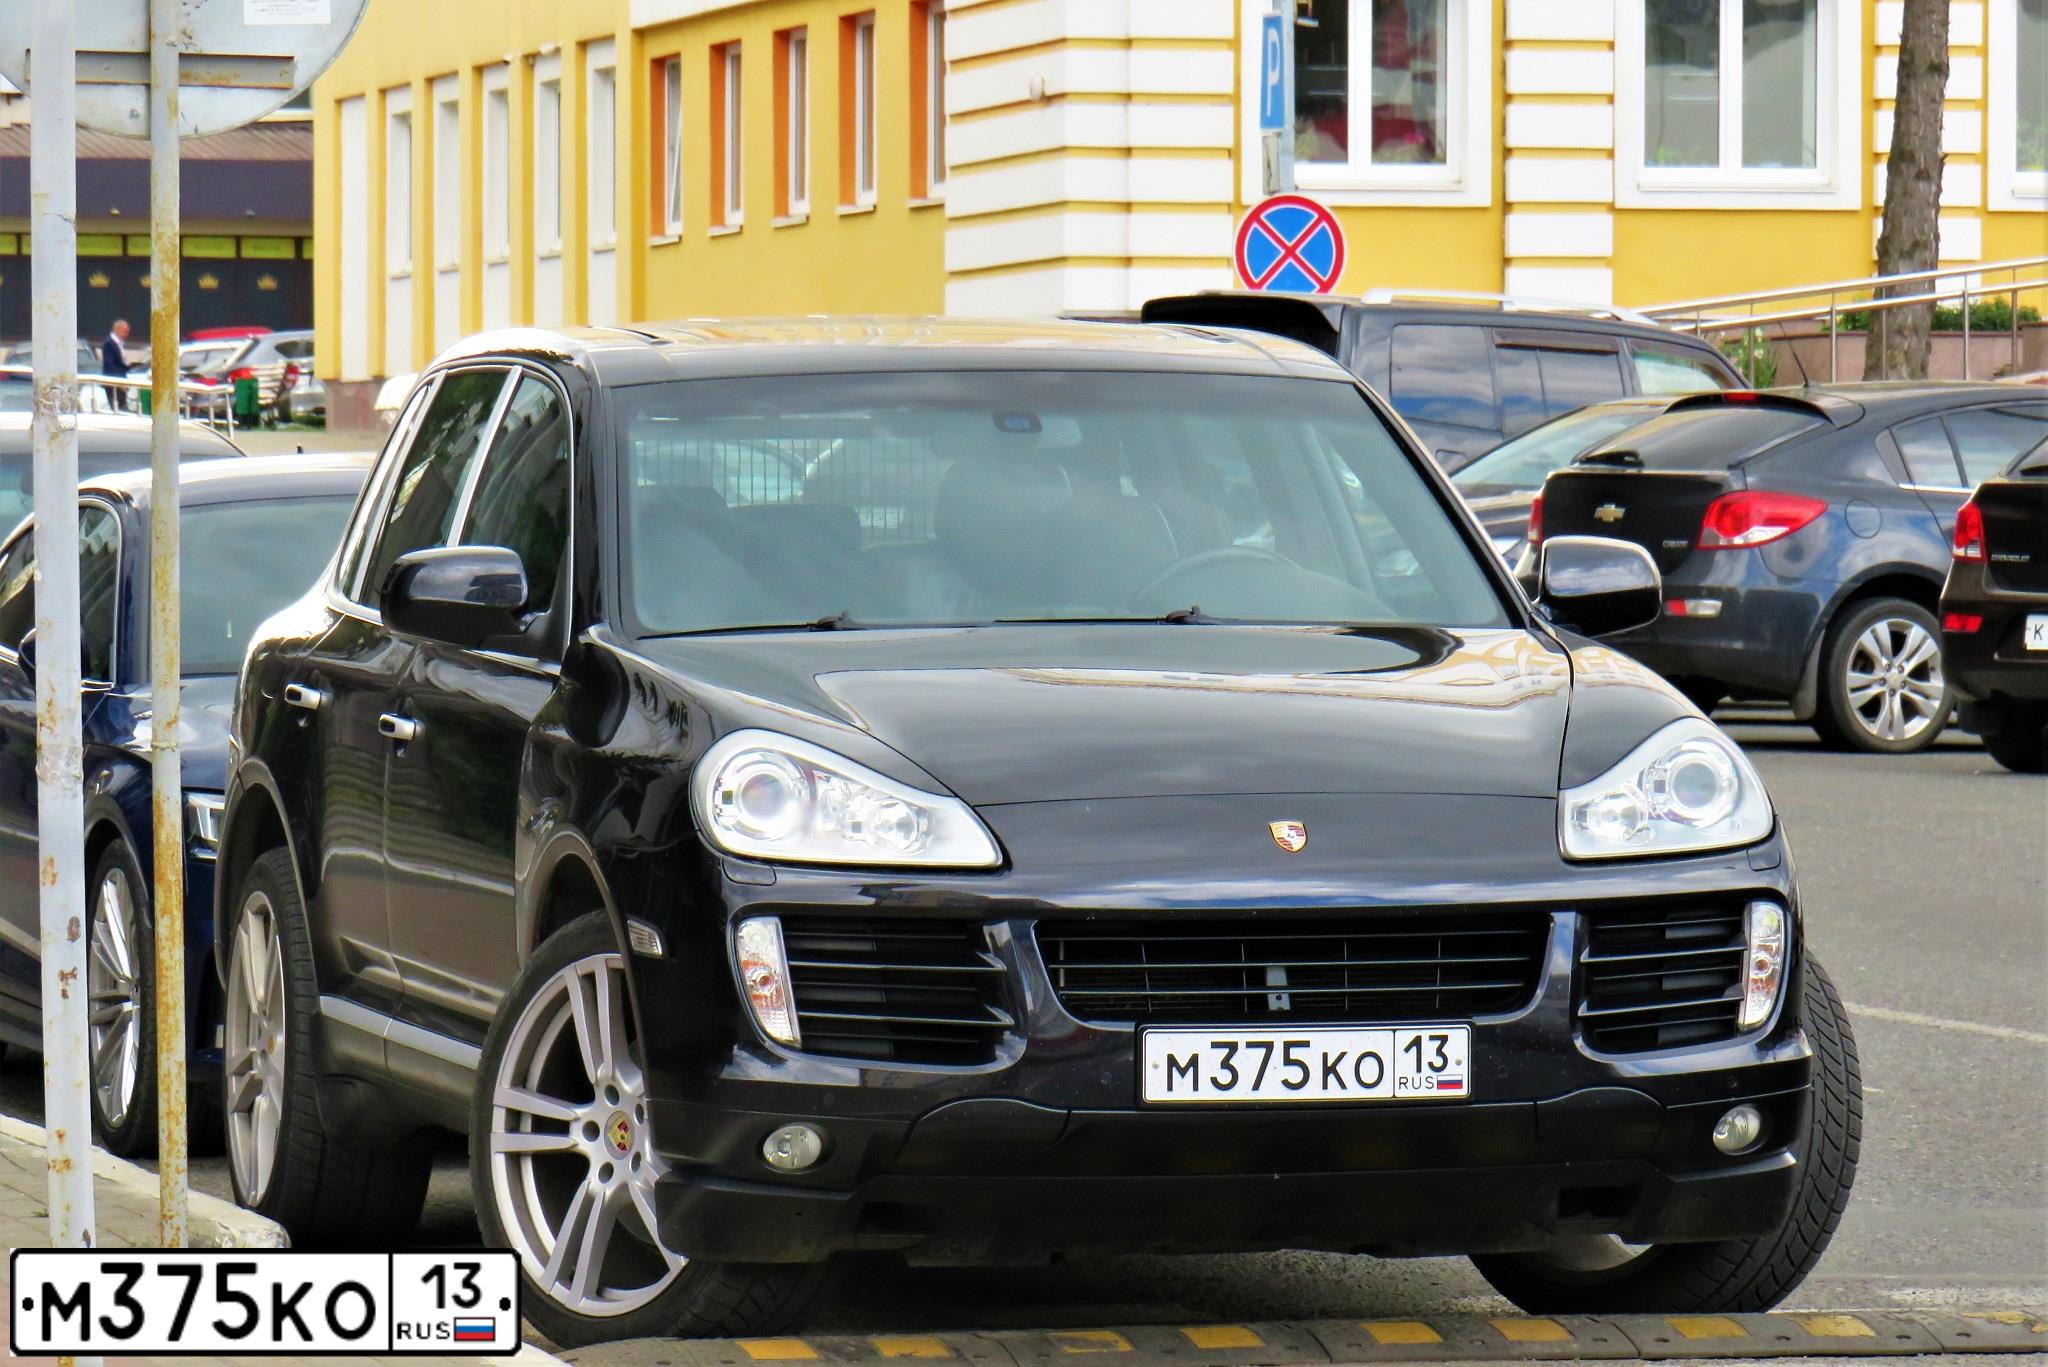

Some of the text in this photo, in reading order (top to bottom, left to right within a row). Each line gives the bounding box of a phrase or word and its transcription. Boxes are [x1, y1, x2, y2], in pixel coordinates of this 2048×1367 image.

[1266, 27, 1280, 117] P
[1166, 1034, 1449, 1092] M375KO 13
[1398, 1075, 1435, 1090] RUS
